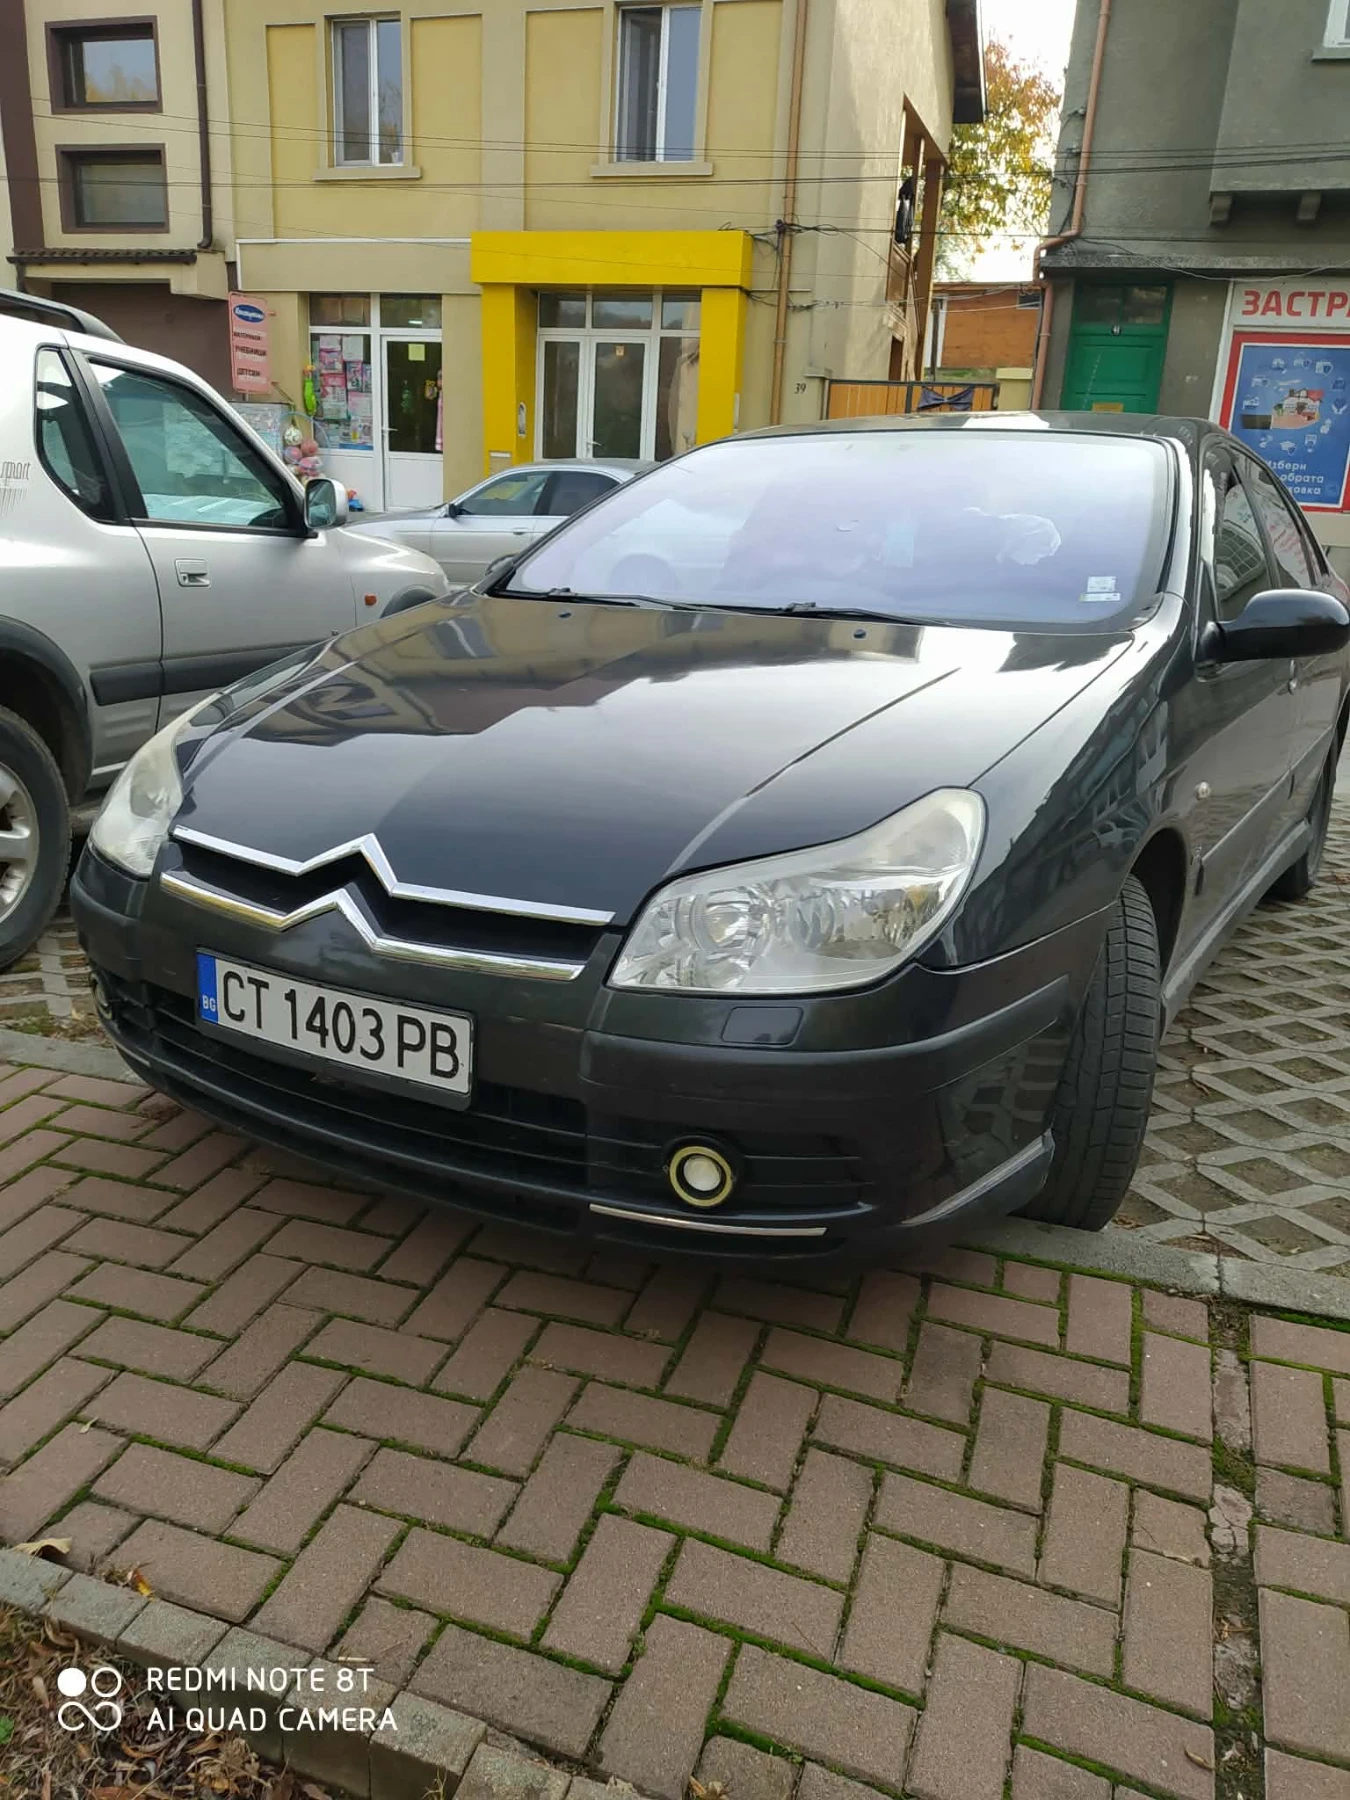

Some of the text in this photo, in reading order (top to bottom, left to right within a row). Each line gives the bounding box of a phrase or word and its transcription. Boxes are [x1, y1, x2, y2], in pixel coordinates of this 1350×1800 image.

[1242, 290, 1350, 317] ЗАСТР
[794, 382, 806, 394] 39
[1279, 473, 1324, 484] обрата
[202, 971, 459, 1079] BG CT 1403 PB
